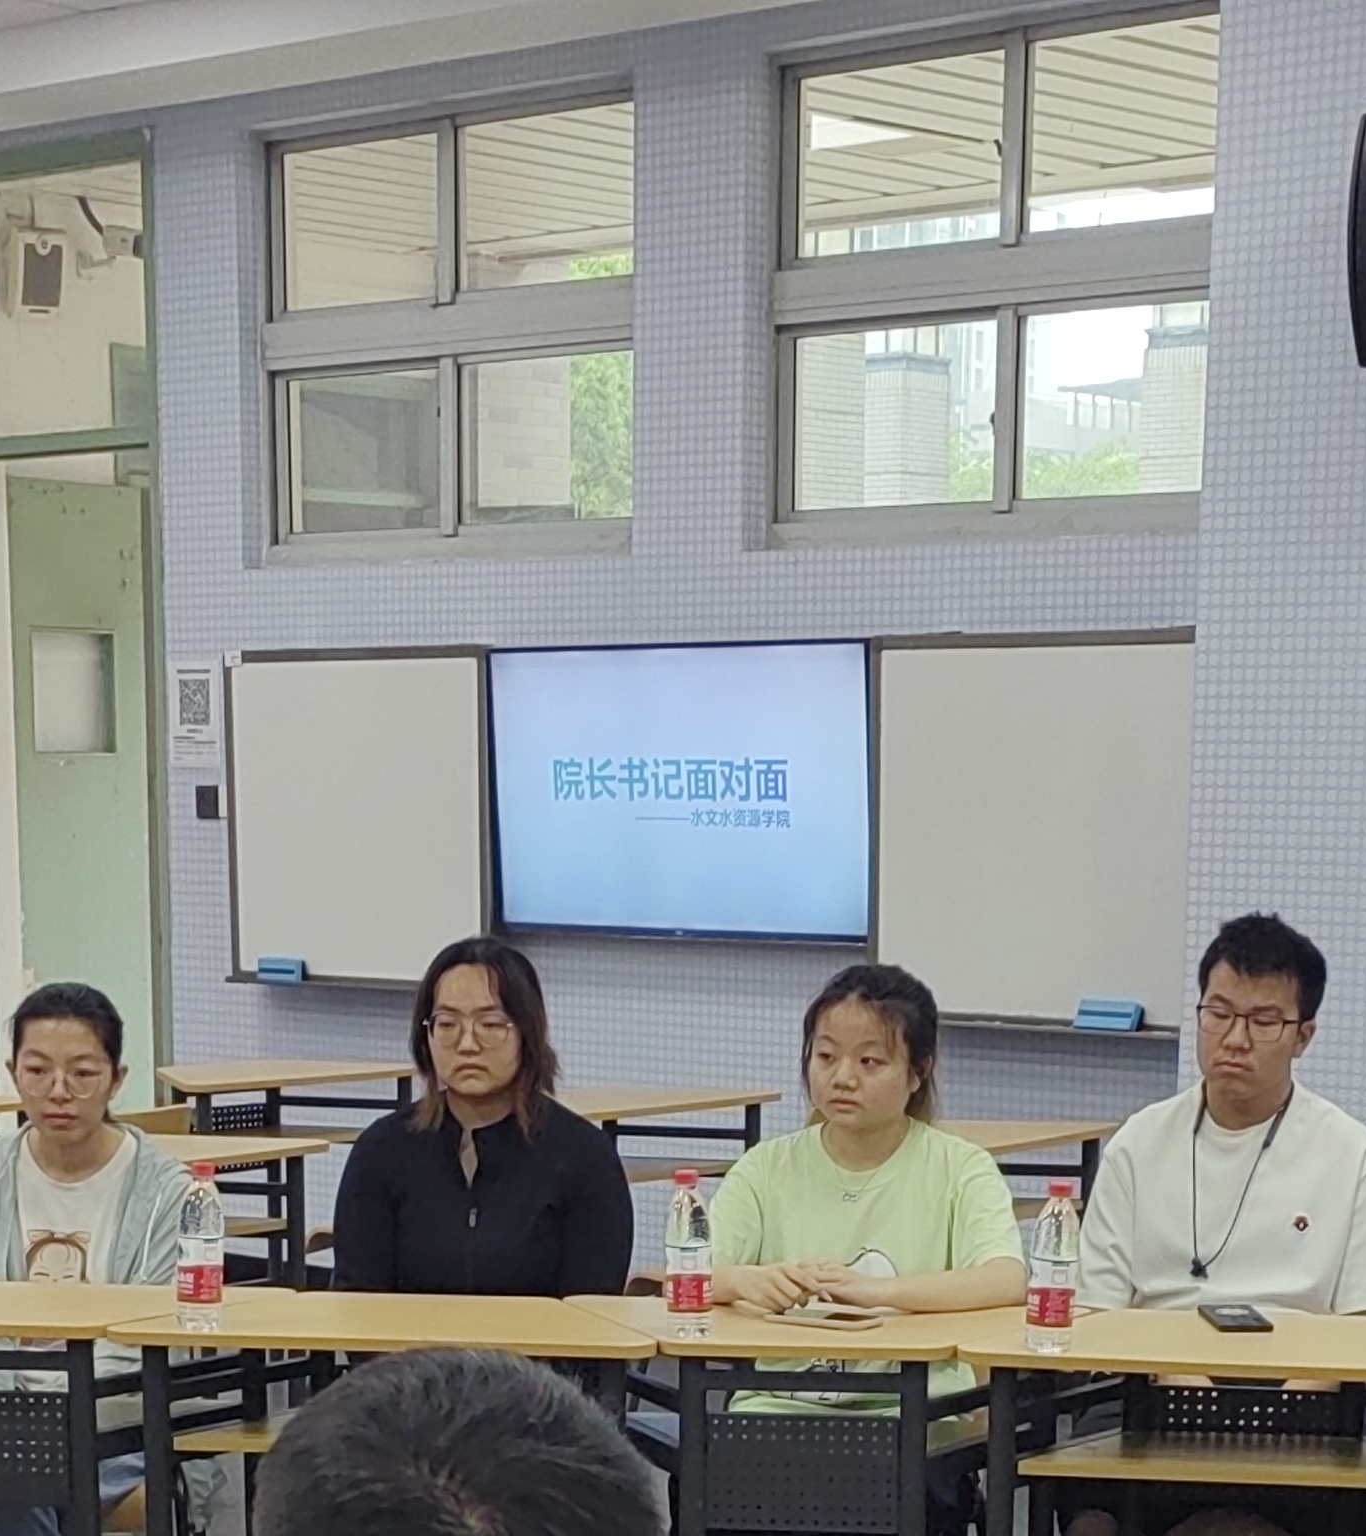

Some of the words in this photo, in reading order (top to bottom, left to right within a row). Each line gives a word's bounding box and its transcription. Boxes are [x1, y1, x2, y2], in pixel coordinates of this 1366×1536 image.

[552, 756, 789, 802] 院长书记面对面
